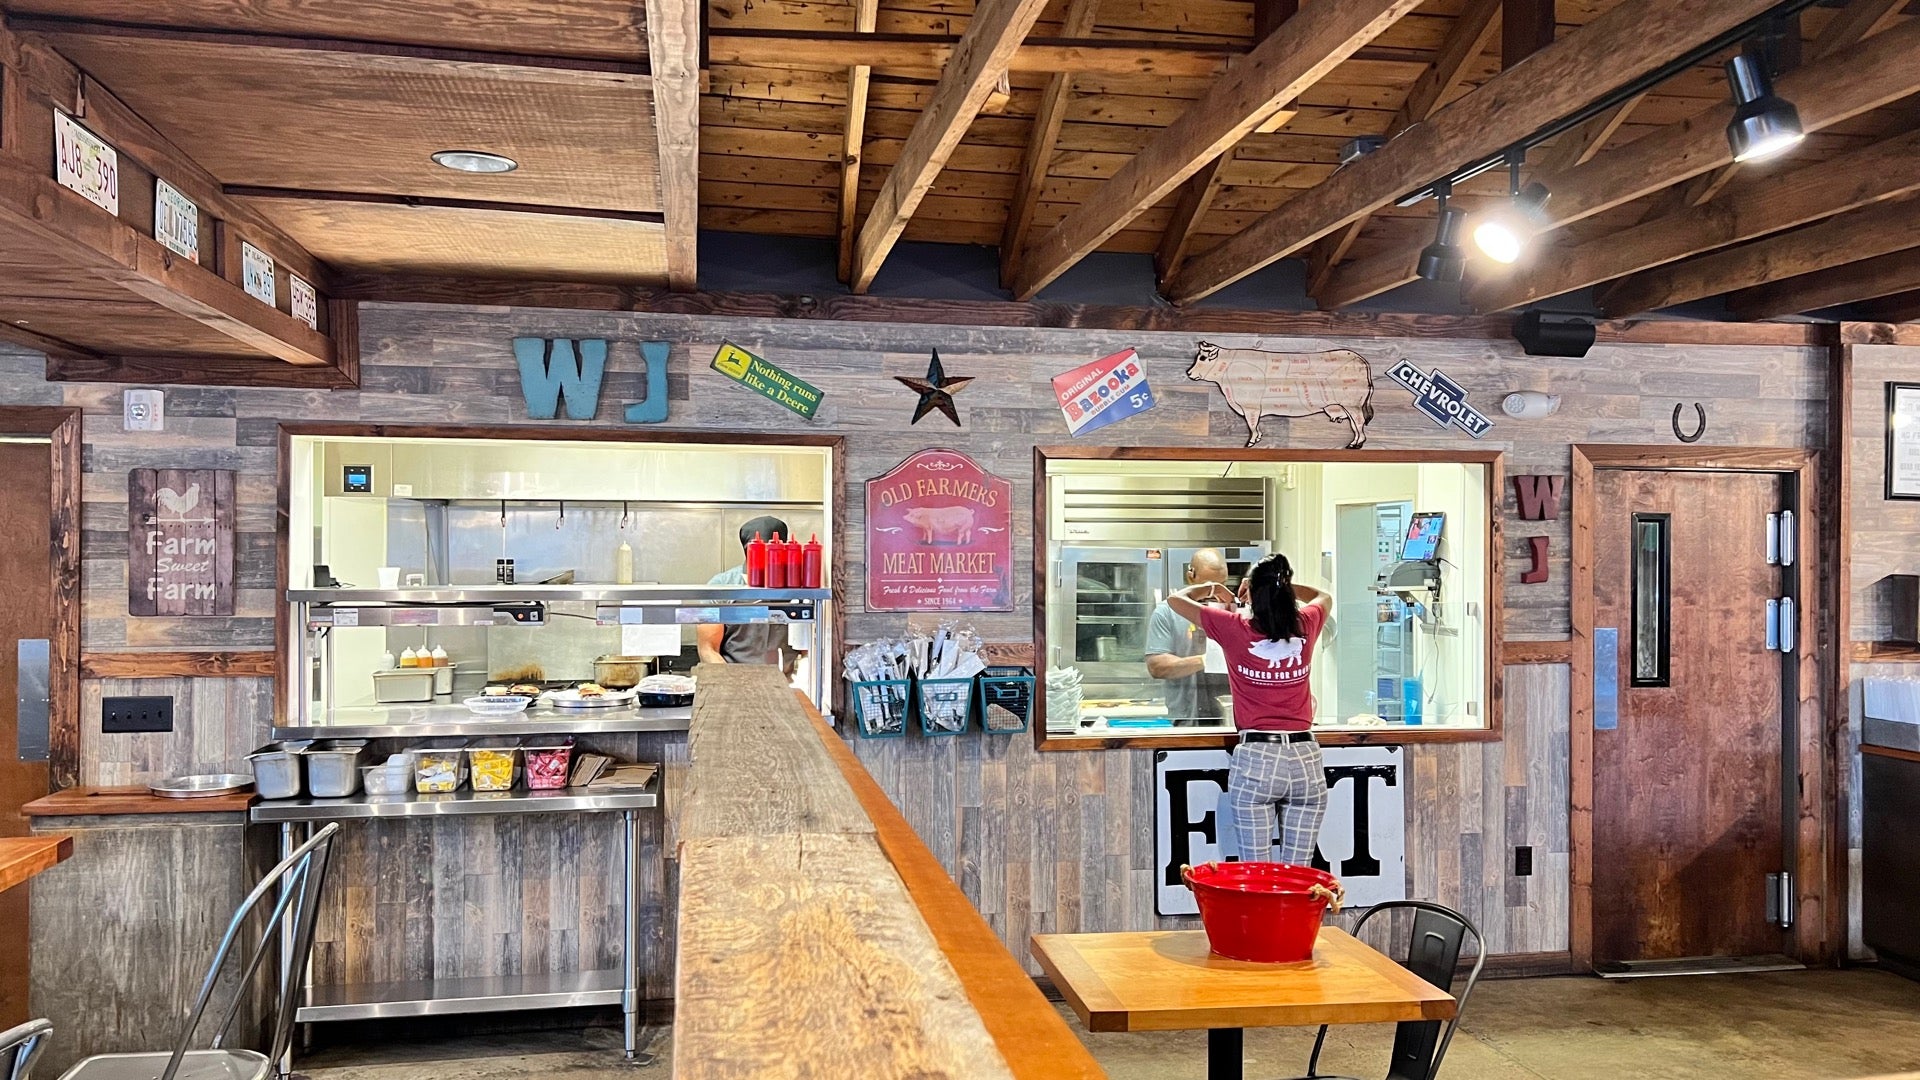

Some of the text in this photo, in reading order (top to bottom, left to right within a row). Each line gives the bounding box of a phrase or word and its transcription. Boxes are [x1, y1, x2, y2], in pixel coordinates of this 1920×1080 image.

[61, 132, 83, 179] AJ8
[95, 156, 116, 200] 390
[744, 372, 809, 414] like a Deere
[751, 360, 818, 402] Nothing runs
[1061, 367, 1104, 401] ORIGINAL
[1065, 362, 1140, 423] Bazooka
[1091, 384, 1131, 416] BUBBLE GUM
[1399, 366, 1487, 434] CHEVROLET
[881, 477, 998, 508] OLD FARMERS
[146, 530, 217, 555] Farm
[153, 557, 210, 573] Sweet
[883, 552, 997, 574] MEAT MARKET
[146, 577, 217, 601] Farm
[883, 586, 901, 595] Fresh
[909, 586, 936, 594] Delicious
[969, 586, 979, 594] the
[980, 585, 998, 594] Farm
[1237, 664, 1272, 680] SMOKED
[1275, 671, 1290, 680] FOR
[1165, 764, 1397, 887] ET
